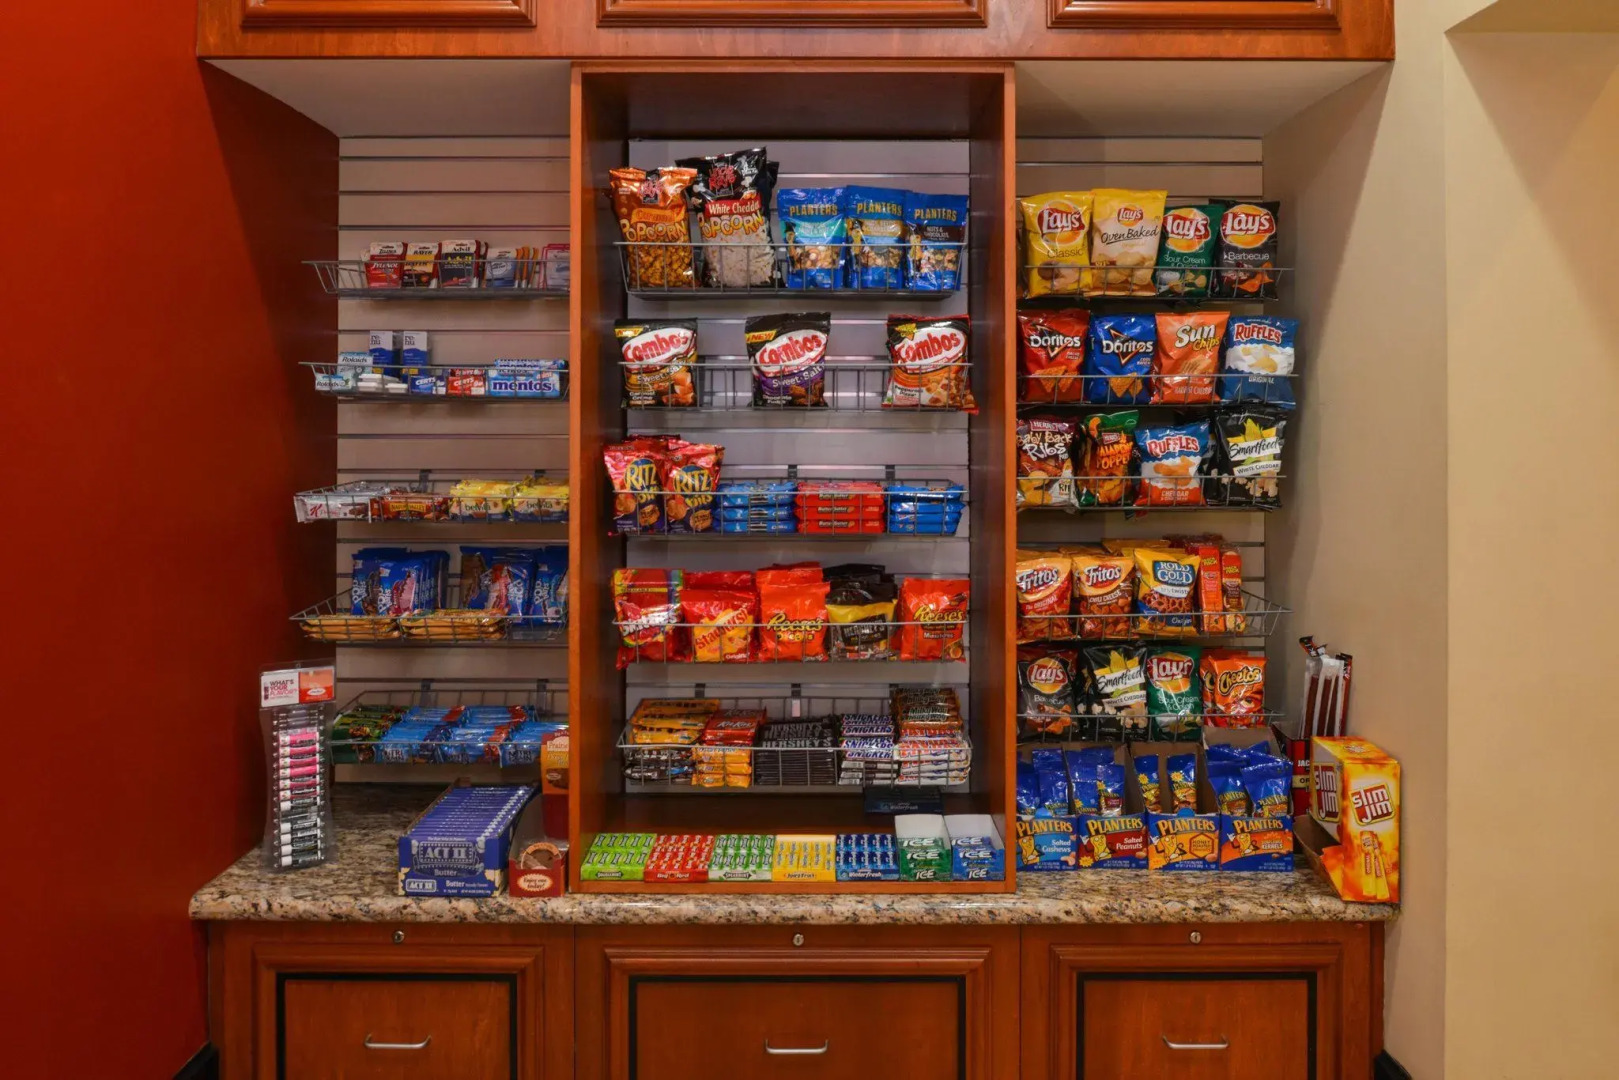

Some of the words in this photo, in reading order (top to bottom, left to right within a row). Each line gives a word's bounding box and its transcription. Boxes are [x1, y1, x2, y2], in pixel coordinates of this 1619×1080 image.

[709, 203, 730, 214] White
[732, 200, 760, 213] Chedda
[789, 203, 838, 216] PLANTERS
[857, 202, 902, 216] PLANTERS
[914, 207, 958, 221] PLANTERS
[1118, 208, 1142, 221] Lay's
[697, 210, 765, 238] POPCORN
[1042, 209, 1081, 234] Lay's
[1225, 212, 1271, 236] Lay's
[620, 219, 687, 241] POPCORN
[1047, 248, 1084, 259] Classic
[1228, 251, 1270, 260] Barbecue
[1028, 334, 1081, 348] Doritos
[1174, 324, 1216, 348] Sun
[1234, 323, 1282, 344] RUFFLES
[623, 333, 689, 362] Combos
[758, 334, 823, 365] Combos
[895, 332, 961, 363] Combos
[1102, 339, 1154, 354] Doritos
[492, 381, 552, 392] mentos
[1146, 435, 1200, 458] RUFFLES
[1229, 436, 1279, 458] Smartfood
[624, 463, 657, 492] RITZ
[674, 469, 709, 494] RITZ
[1159, 561, 1191, 572] ROLD
[1017, 568, 1059, 593] Fritos
[1084, 565, 1122, 586] Fritos
[1157, 570, 1193, 584] GOLD
[913, 605, 964, 623] Reese's
[1031, 664, 1064, 684] Lay's
[1097, 670, 1143, 691] Smartfood
[1219, 665, 1262, 694] Cheetos
[1298, 759, 1310, 767] JAC
[1352, 787, 1390, 809] slim
[1361, 800, 1393, 824] jim
[1016, 820, 1073, 837] PLANTERS
[1087, 818, 1143, 836] PLANTERS
[1157, 818, 1216, 836] PLANTERS
[1233, 819, 1284, 834] PLANTERS
[903, 837, 935, 847] ICE
[951, 836, 983, 846] ICE
[1116, 842, 1143, 850] Peanuts
[424, 847, 451, 859] ACT
[906, 851, 940, 860] ICE
[959, 850, 993, 859] ICE
[434, 868, 458, 877] Butter
[916, 869, 936, 879] ICE
[968, 868, 988, 879] ICE
[445, 880, 466, 888] Butter
